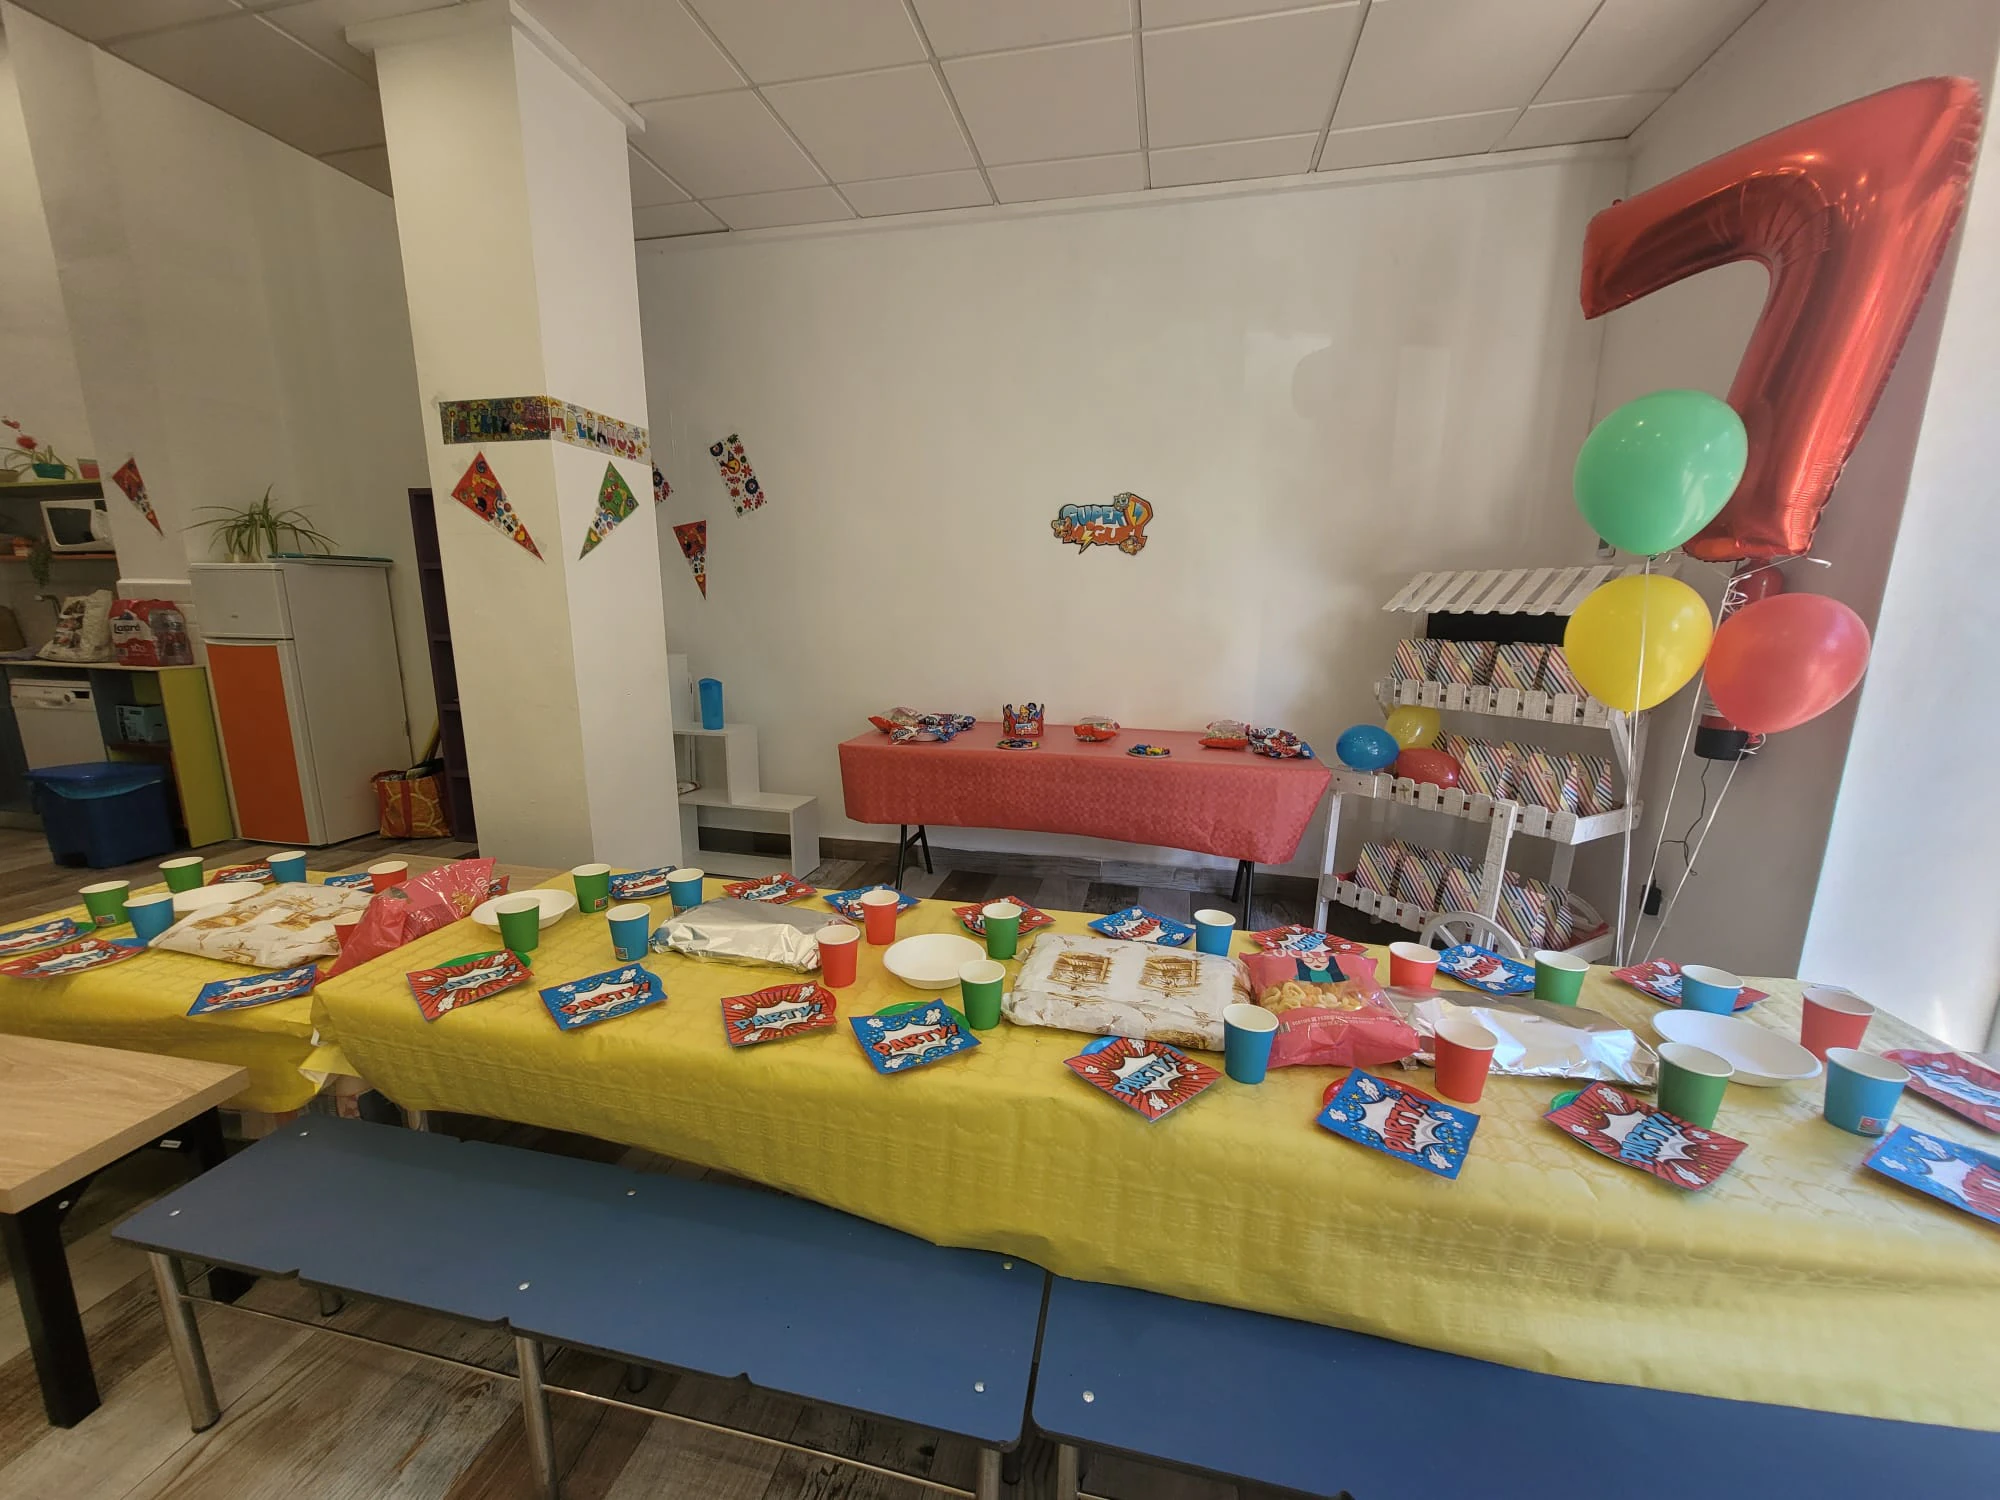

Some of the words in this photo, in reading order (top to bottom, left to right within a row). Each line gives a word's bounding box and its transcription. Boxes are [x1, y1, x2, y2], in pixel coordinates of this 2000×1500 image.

[1061, 503, 1126, 528] SUPER
[206, 977, 311, 1004] PARTY!
[423, 964, 517, 996] PARTY!
[560, 982, 651, 1015] PARTY!
[733, 1003, 823, 1030] PARTY!
[872, 1024, 960, 1056] PARTY!
[1112, 1053, 1181, 1096] PARTY!
[1383, 1094, 1431, 1154] PARTY!
[1619, 1112, 1684, 1165] PARTY!
